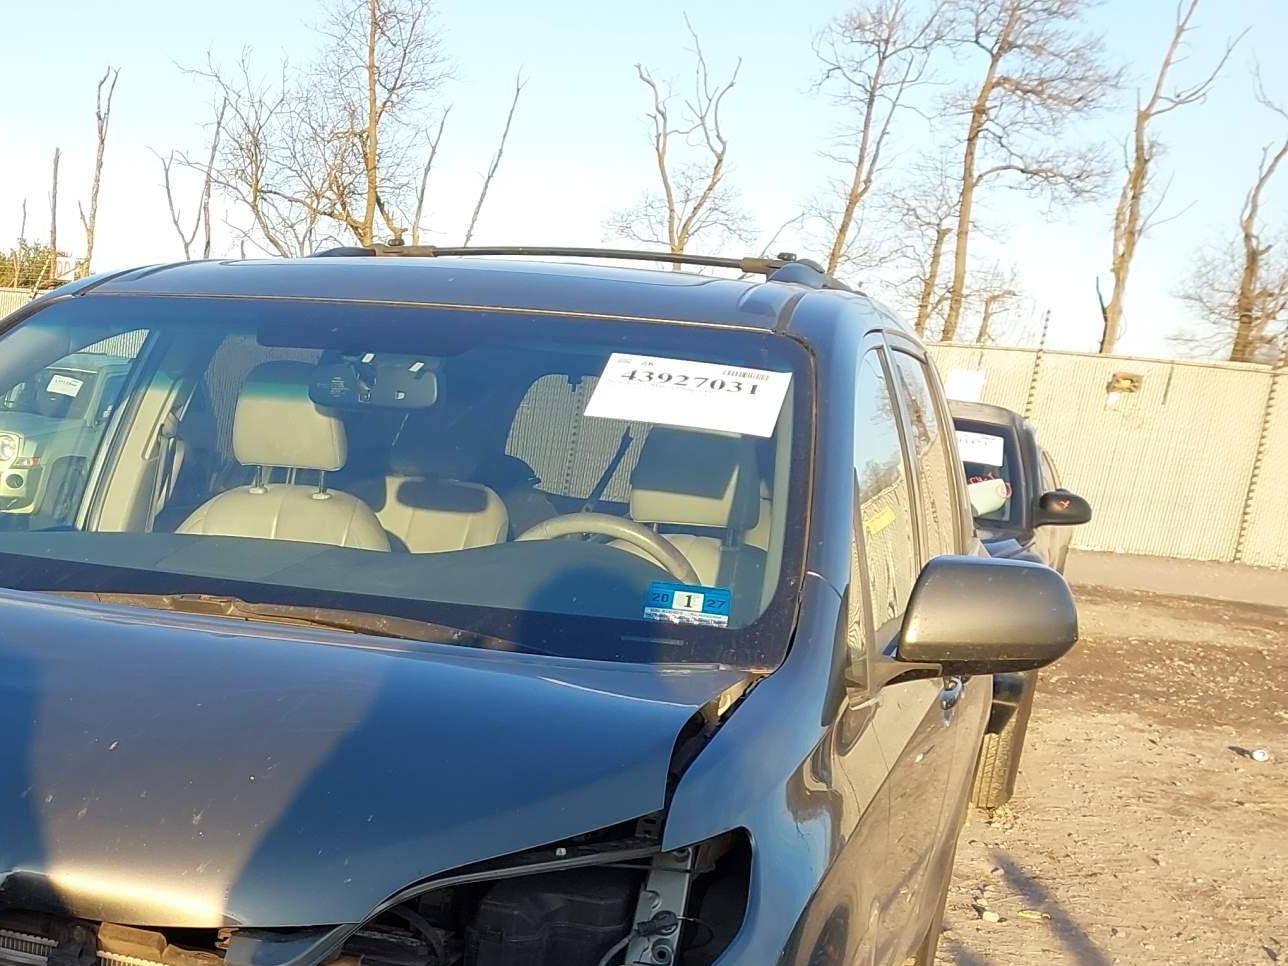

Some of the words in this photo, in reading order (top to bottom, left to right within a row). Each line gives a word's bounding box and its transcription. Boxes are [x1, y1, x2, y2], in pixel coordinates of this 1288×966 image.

[621, 369, 760, 395] 43927031
[652, 592, 670, 603] 20
[683, 594, 694, 609] 1
[706, 599, 727, 609] 27
